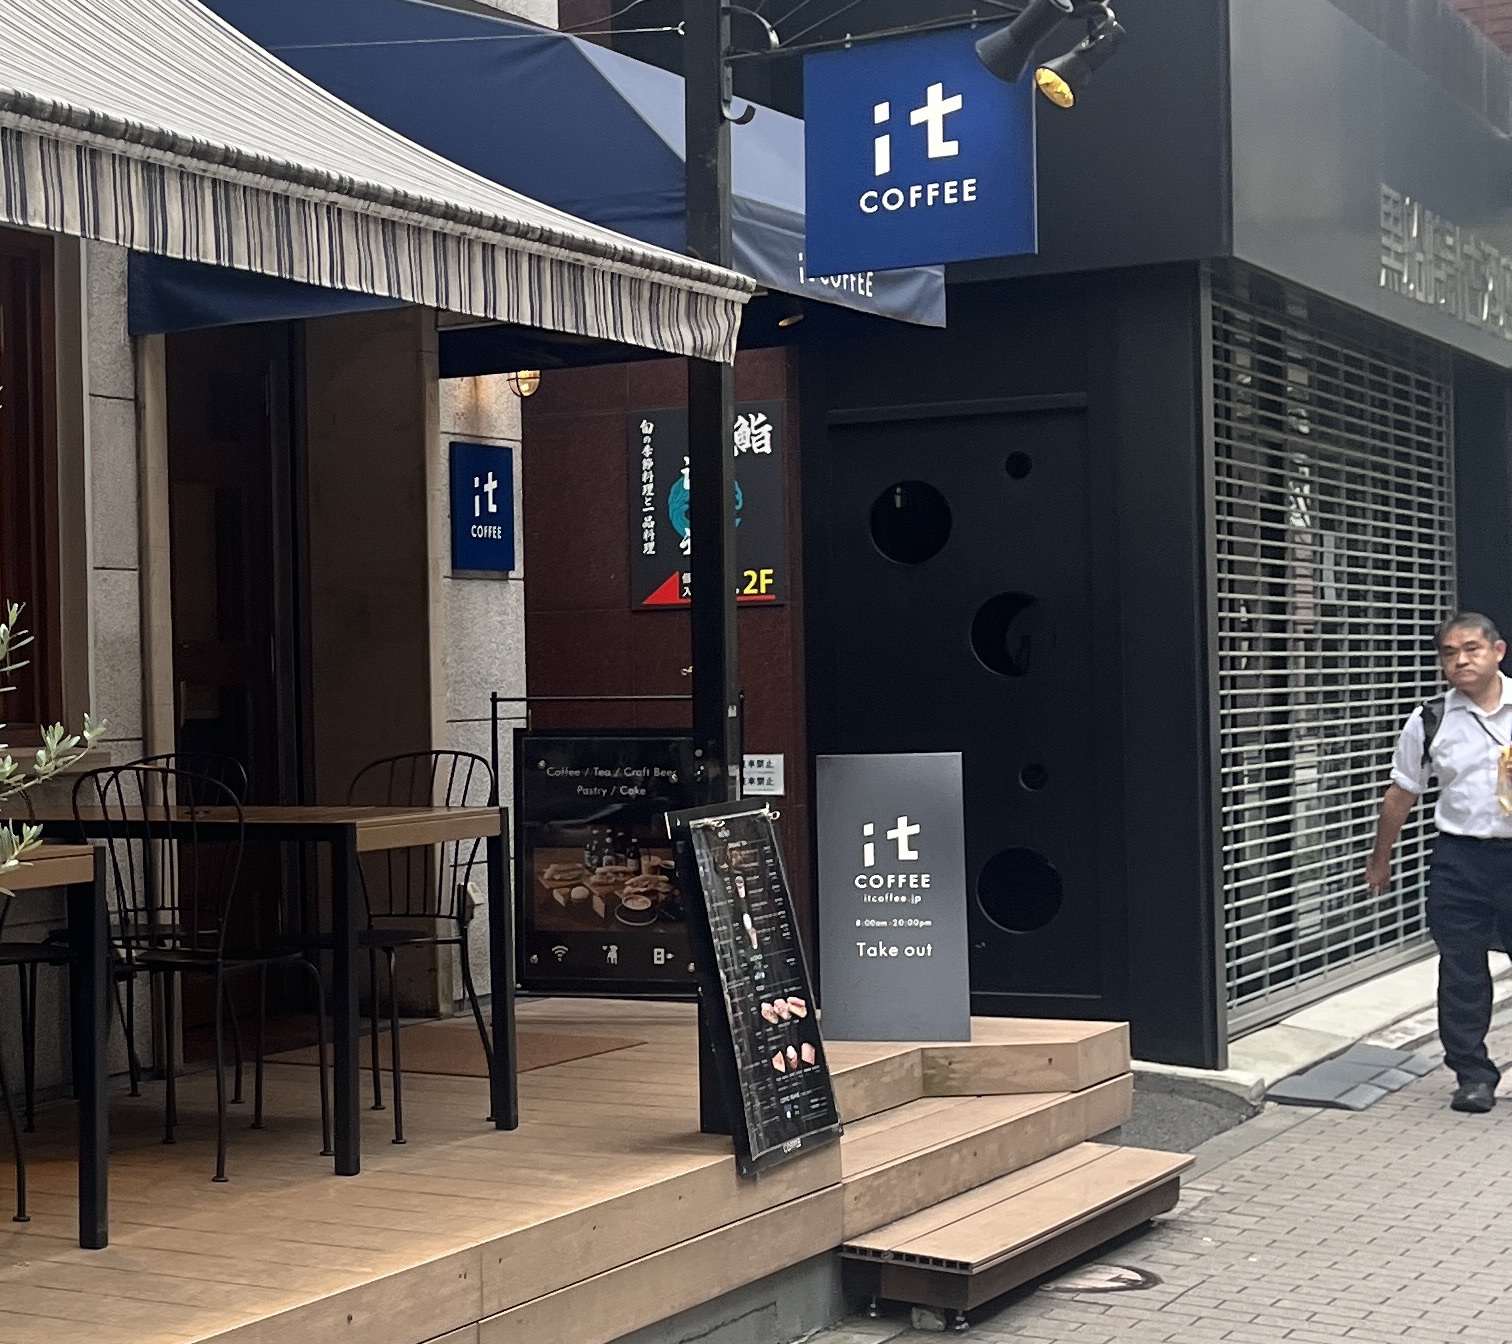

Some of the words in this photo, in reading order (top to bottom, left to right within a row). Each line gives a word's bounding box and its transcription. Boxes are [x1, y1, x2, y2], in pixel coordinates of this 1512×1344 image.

[874, 82, 963, 176] it
[860, 178, 976, 214] COFFEE
[474, 471, 498, 517] it
[471, 524, 502, 539] COFFEE
[743, 569, 774, 594] 2F
[546, 767, 581, 777] Coffee
[593, 767, 611, 777] Tea
[623, 767, 649, 777] Craft
[577, 785, 607, 796] Pastry
[620, 785, 646, 796] Cake
[863, 816, 920, 867] it
[854, 874, 931, 888] COFFEE
[856, 941, 899, 957] Take
[904, 943, 933, 957] out
